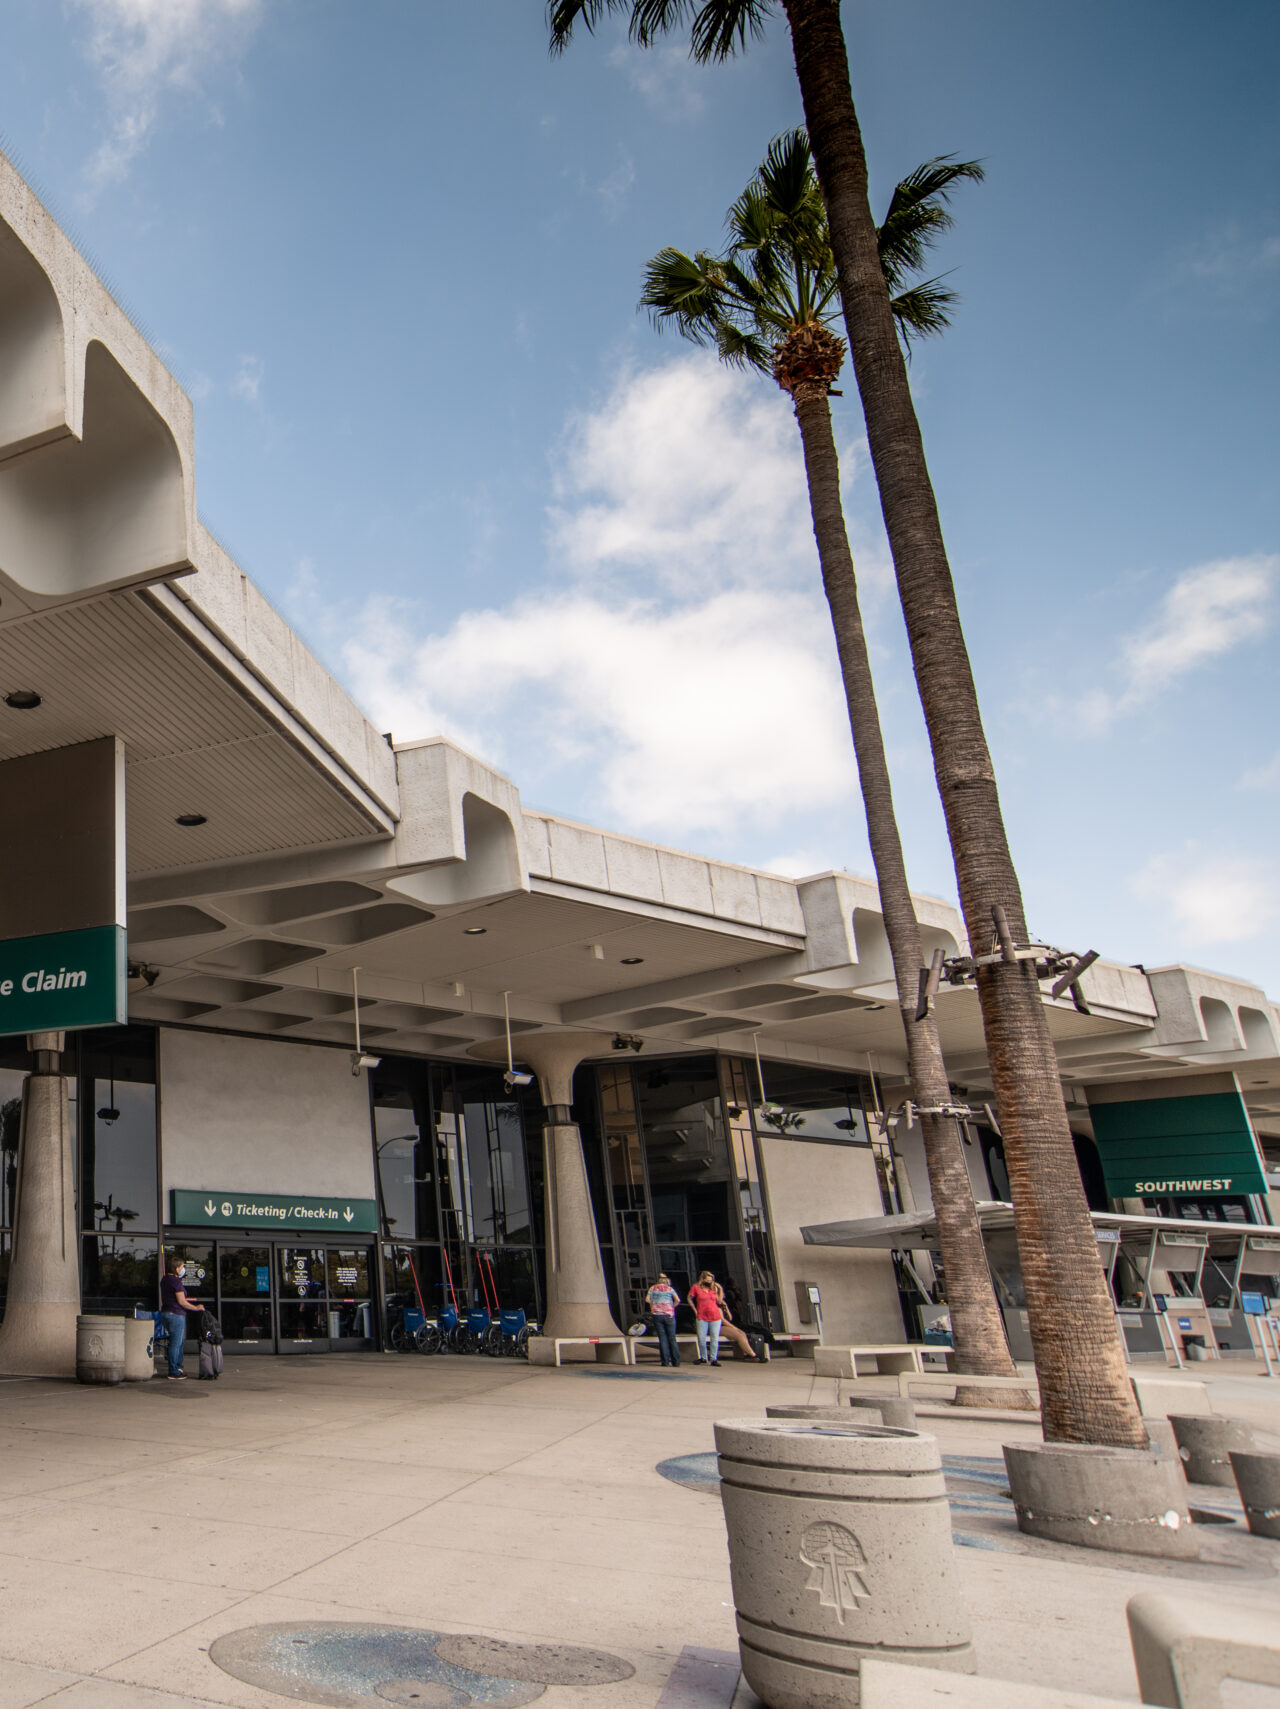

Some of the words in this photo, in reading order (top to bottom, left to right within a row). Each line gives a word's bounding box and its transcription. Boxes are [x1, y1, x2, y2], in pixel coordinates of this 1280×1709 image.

[21, 967, 87, 993] Claim
[1135, 1179, 1232, 1193] SOUTHWEST
[236, 1203, 287, 1220] Ticketing
[294, 1206, 339, 1219] Check-In
